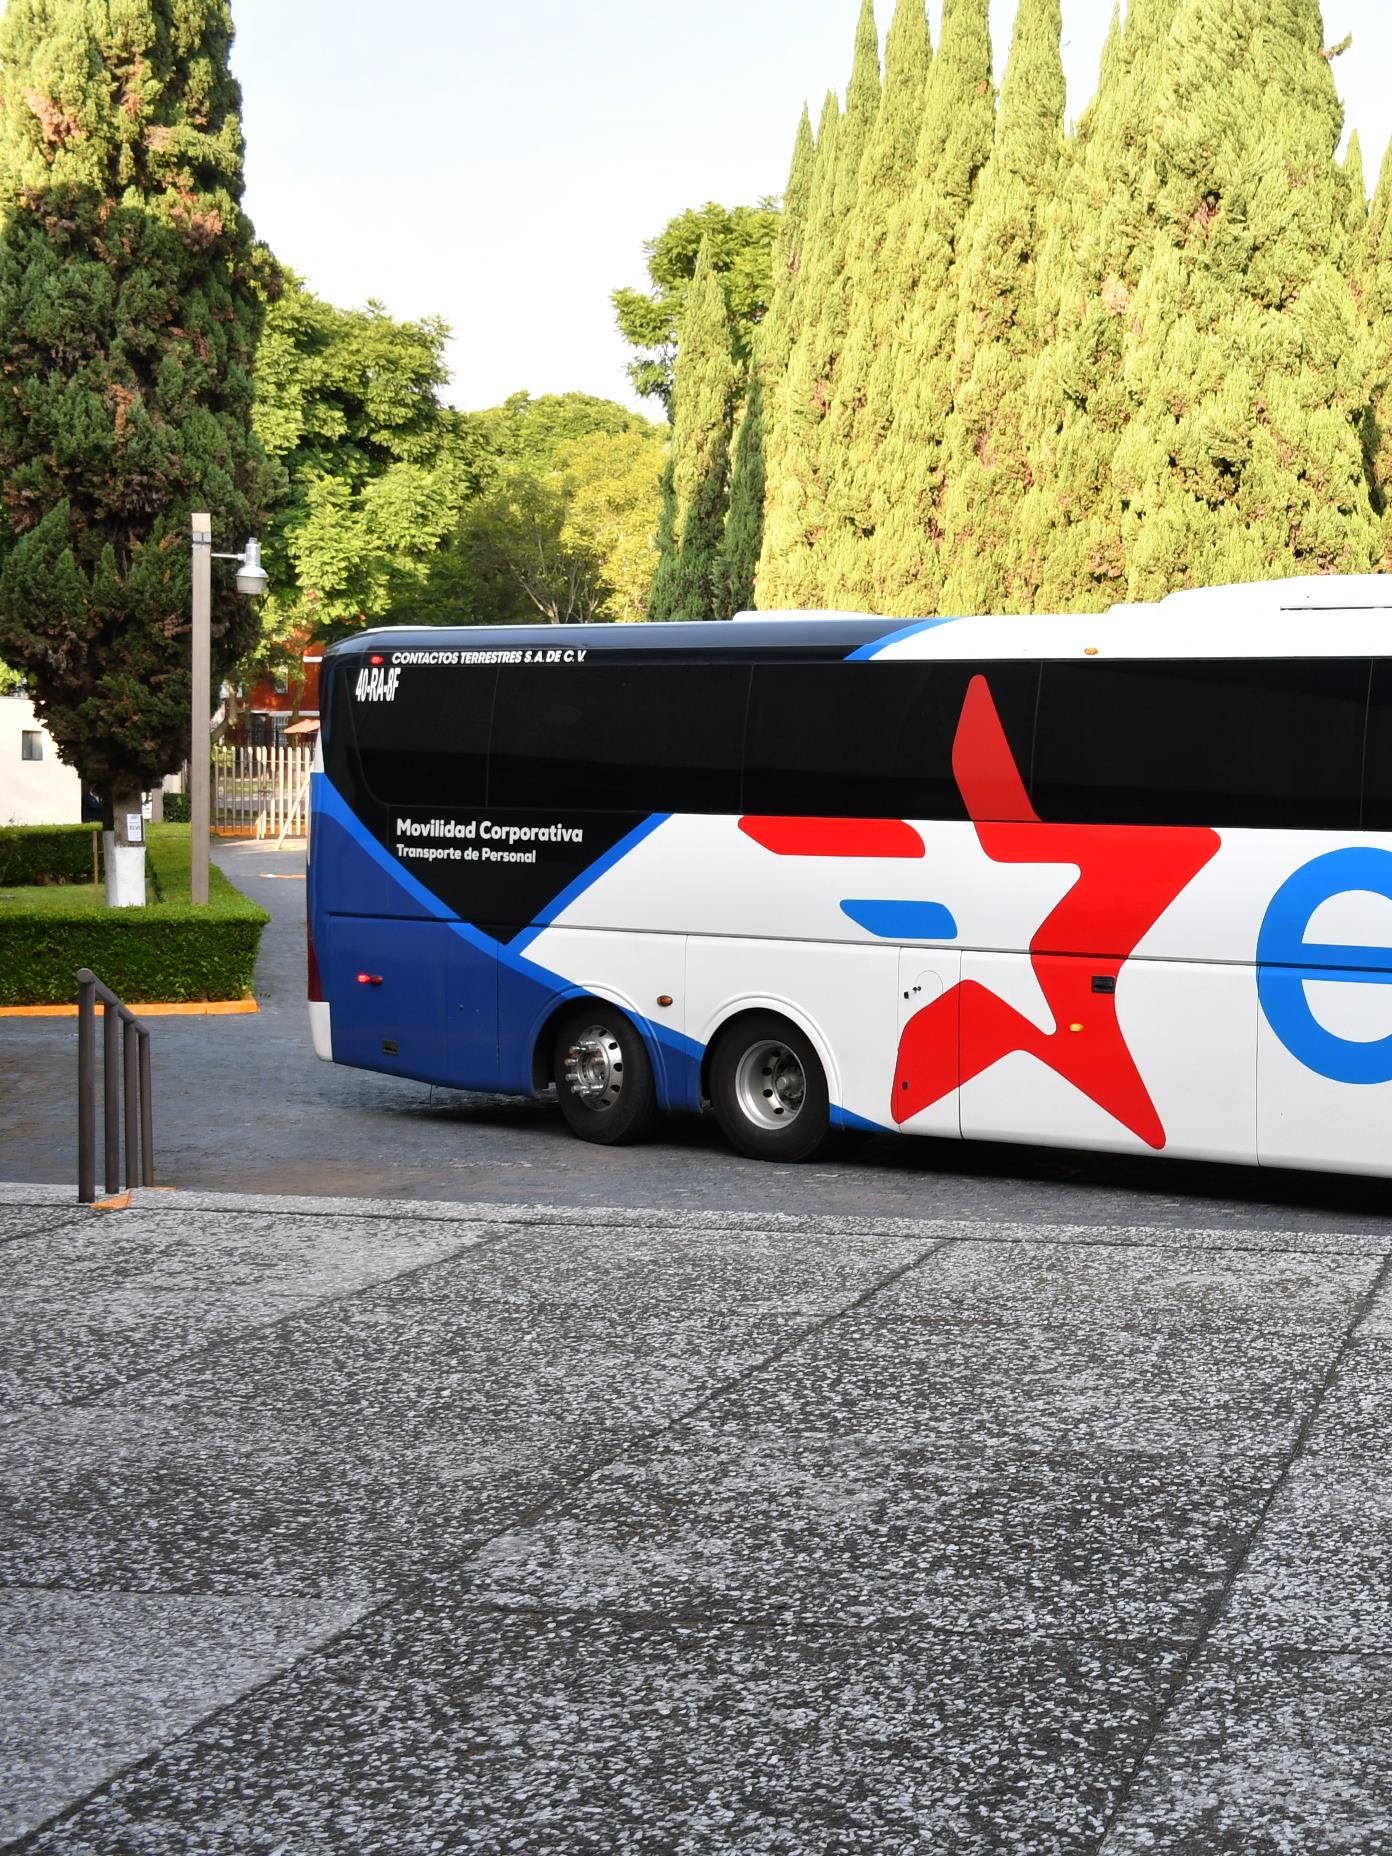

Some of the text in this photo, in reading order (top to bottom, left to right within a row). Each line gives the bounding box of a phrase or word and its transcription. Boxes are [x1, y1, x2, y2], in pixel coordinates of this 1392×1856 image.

[392, 652, 459, 665] CONTACTOS
[460, 651, 523, 664] TERRESTRES
[355, 667, 401, 702] 40-RA-8F
[396, 818, 584, 844] Movilidad Corporativa
[396, 844, 537, 863] Transporte de Personal
